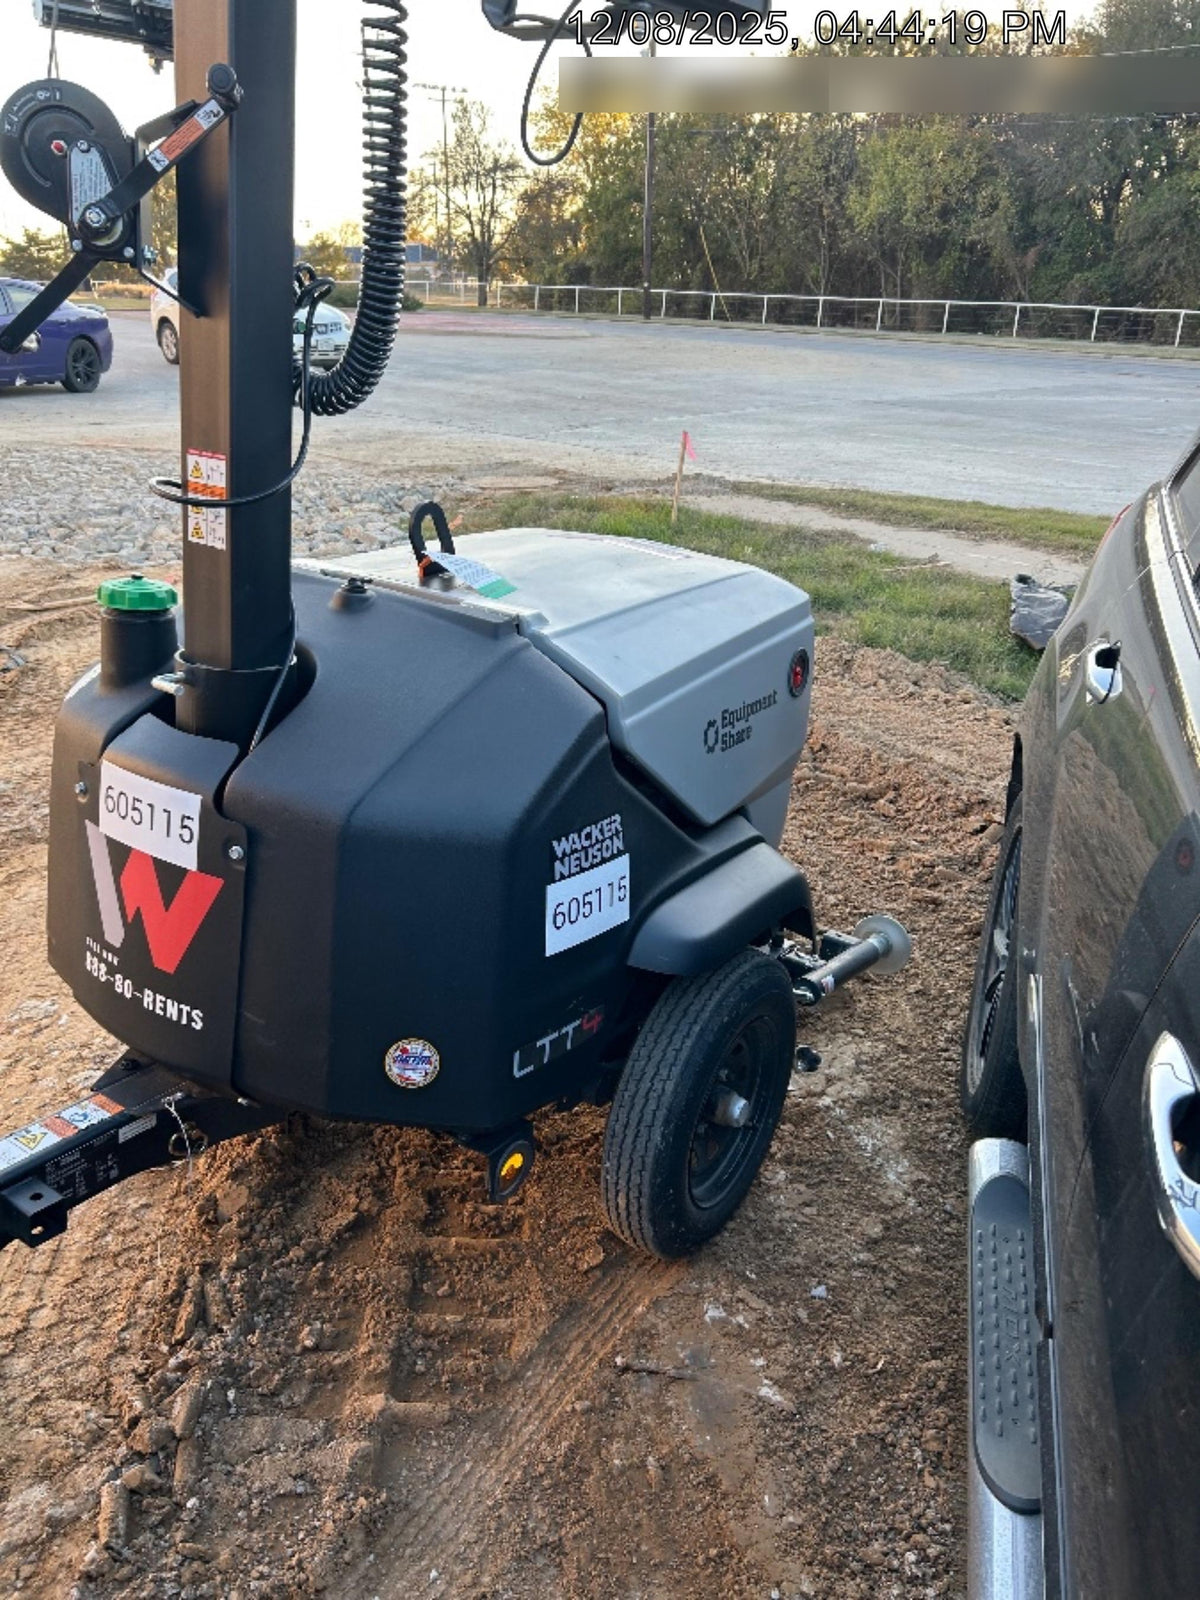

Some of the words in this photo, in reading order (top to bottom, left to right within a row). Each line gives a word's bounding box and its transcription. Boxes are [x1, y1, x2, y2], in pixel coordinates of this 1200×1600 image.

[721, 688, 778, 730] Equipment
[720, 724, 753, 753] Share
[104, 785, 195, 844] 605115
[552, 813, 623, 858] WACKER
[554, 831, 625, 881] NEUSON
[552, 875, 628, 931] 605115
[84, 950, 204, 1031] 888-80-RENTS
[512, 1010, 604, 1079] LTT4
